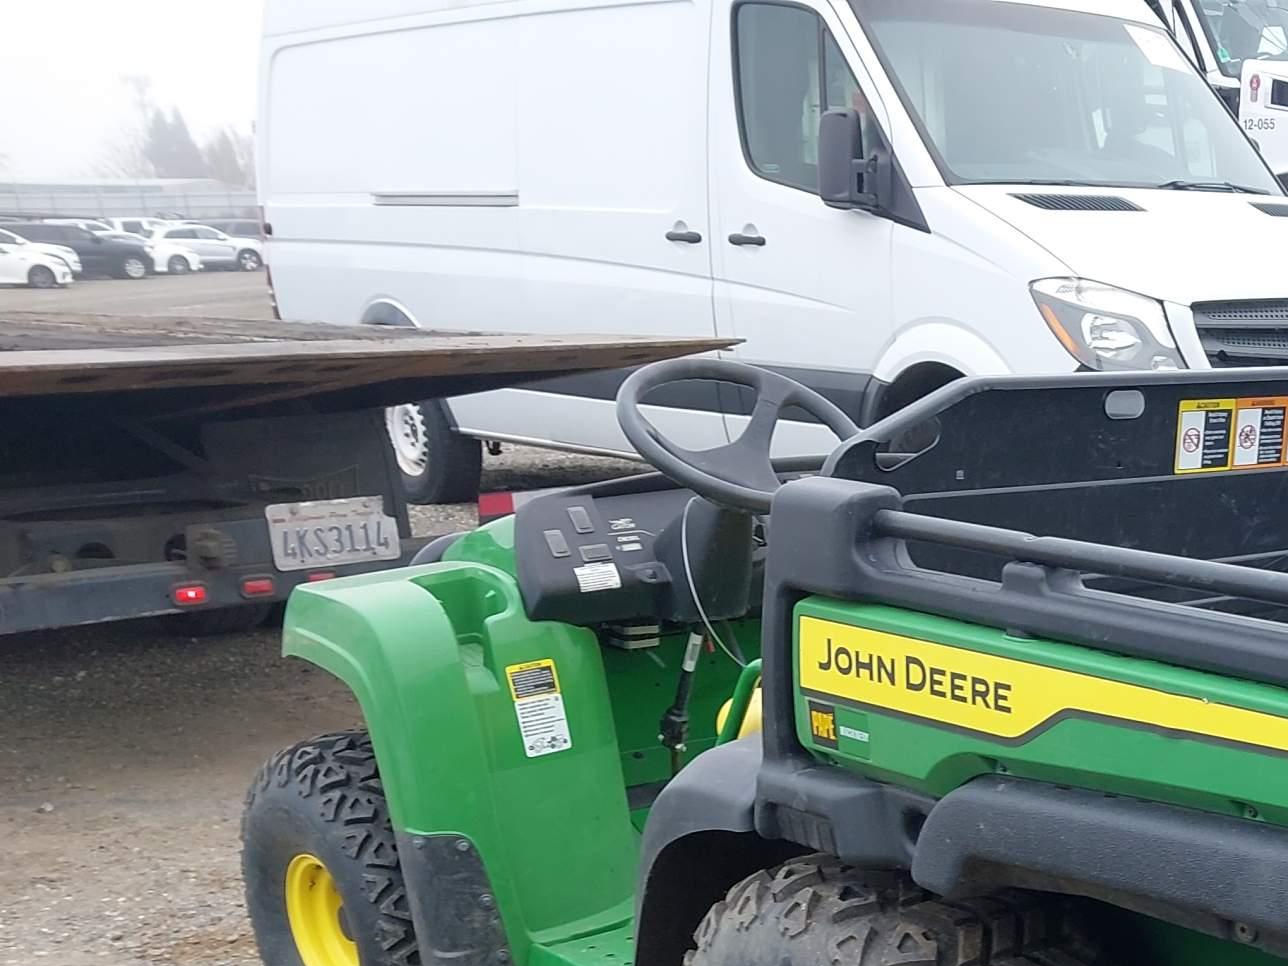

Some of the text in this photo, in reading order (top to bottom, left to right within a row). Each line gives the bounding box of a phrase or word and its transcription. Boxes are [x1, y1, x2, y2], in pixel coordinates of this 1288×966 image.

[1243, 118, 1276, 130] 12-055
[282, 520, 390, 560] 4KS3114
[818, 638, 1013, 715] JOHN DEERE
